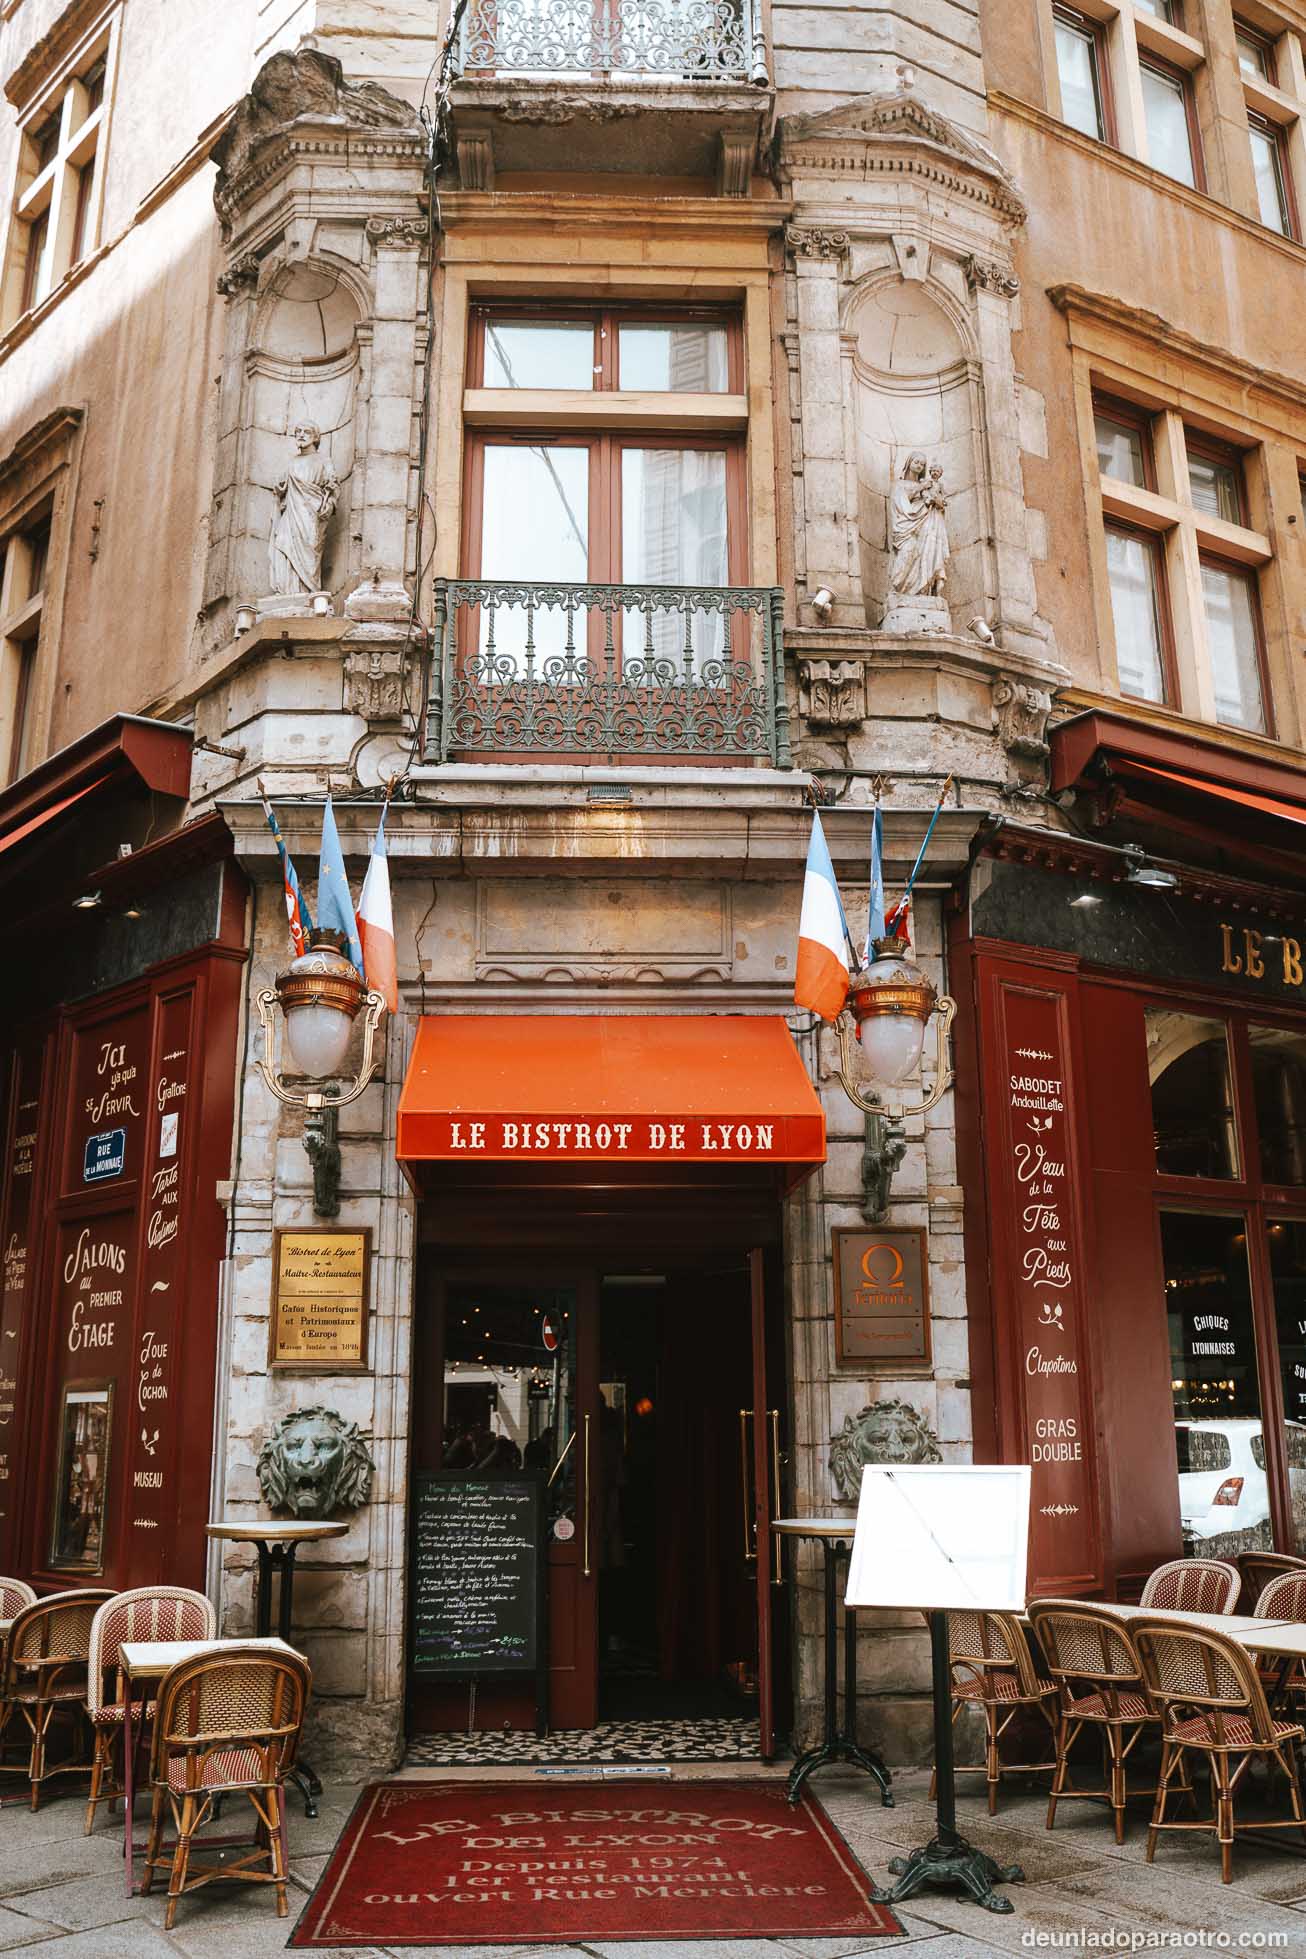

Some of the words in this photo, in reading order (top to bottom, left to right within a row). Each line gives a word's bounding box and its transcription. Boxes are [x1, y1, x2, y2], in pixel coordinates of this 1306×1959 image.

[1220, 923, 1265, 979] LE
[1010, 1075, 1062, 1096] SABODET
[85, 1097, 94, 1112] SE
[92, 1091, 140, 1123] SERVIR
[1010, 1093, 1064, 1112] Andouillette
[450, 1122, 486, 1149] LE
[501, 1122, 633, 1149] BISTROT
[648, 1123, 686, 1150] DE
[701, 1123, 774, 1150] LYON
[97, 1143, 111, 1157] RUE
[96, 1155, 122, 1172] MONNAIE
[1014, 1143, 1065, 1183] Veau
[151, 1161, 179, 1200] Tarte
[1029, 1180, 1041, 1197] de
[1042, 1179, 1054, 1195] la
[162, 1189, 178, 1204] AUX
[1022, 1203, 1061, 1233] Tête
[320, 1247, 332, 1257] de
[1046, 1239, 1068, 1252] aux
[64, 1228, 126, 1284] SALONS
[1021, 1246, 1072, 1289] Pieds
[80, 1275, 92, 1290] au
[90, 1290, 123, 1307] PREMIER
[282, 1304, 305, 1313] Cafés
[310, 1304, 359, 1315] Historiques
[285, 1317, 294, 1326] et
[300, 1316, 356, 1326] Patrimoniaux
[1193, 1315, 1229, 1331] CHIQUES
[1192, 1341, 1236, 1355] LYONNAISES
[152, 1363, 162, 1378] de
[1025, 1345, 1078, 1379] Clapotons
[138, 1370, 168, 1412] COCHON
[1035, 1418, 1077, 1438] GRAS
[1032, 1441, 1083, 1462] DOUBLE
[133, 1471, 163, 1488] MUSEAU
[372, 1818, 480, 1846] LE
[491, 1809, 808, 1841] BISTROT
[462, 1836, 546, 1849] DE
[566, 1832, 722, 1848] LYON
[458, 1857, 609, 1875] Depuis
[630, 1855, 728, 1870] 1974
[443, 1874, 510, 1889] 1er
[522, 1870, 752, 1888] restaurant
[362, 1891, 513, 1905] ouvert
[530, 1887, 617, 1902] Rue
[629, 1881, 830, 1901] Mercière
